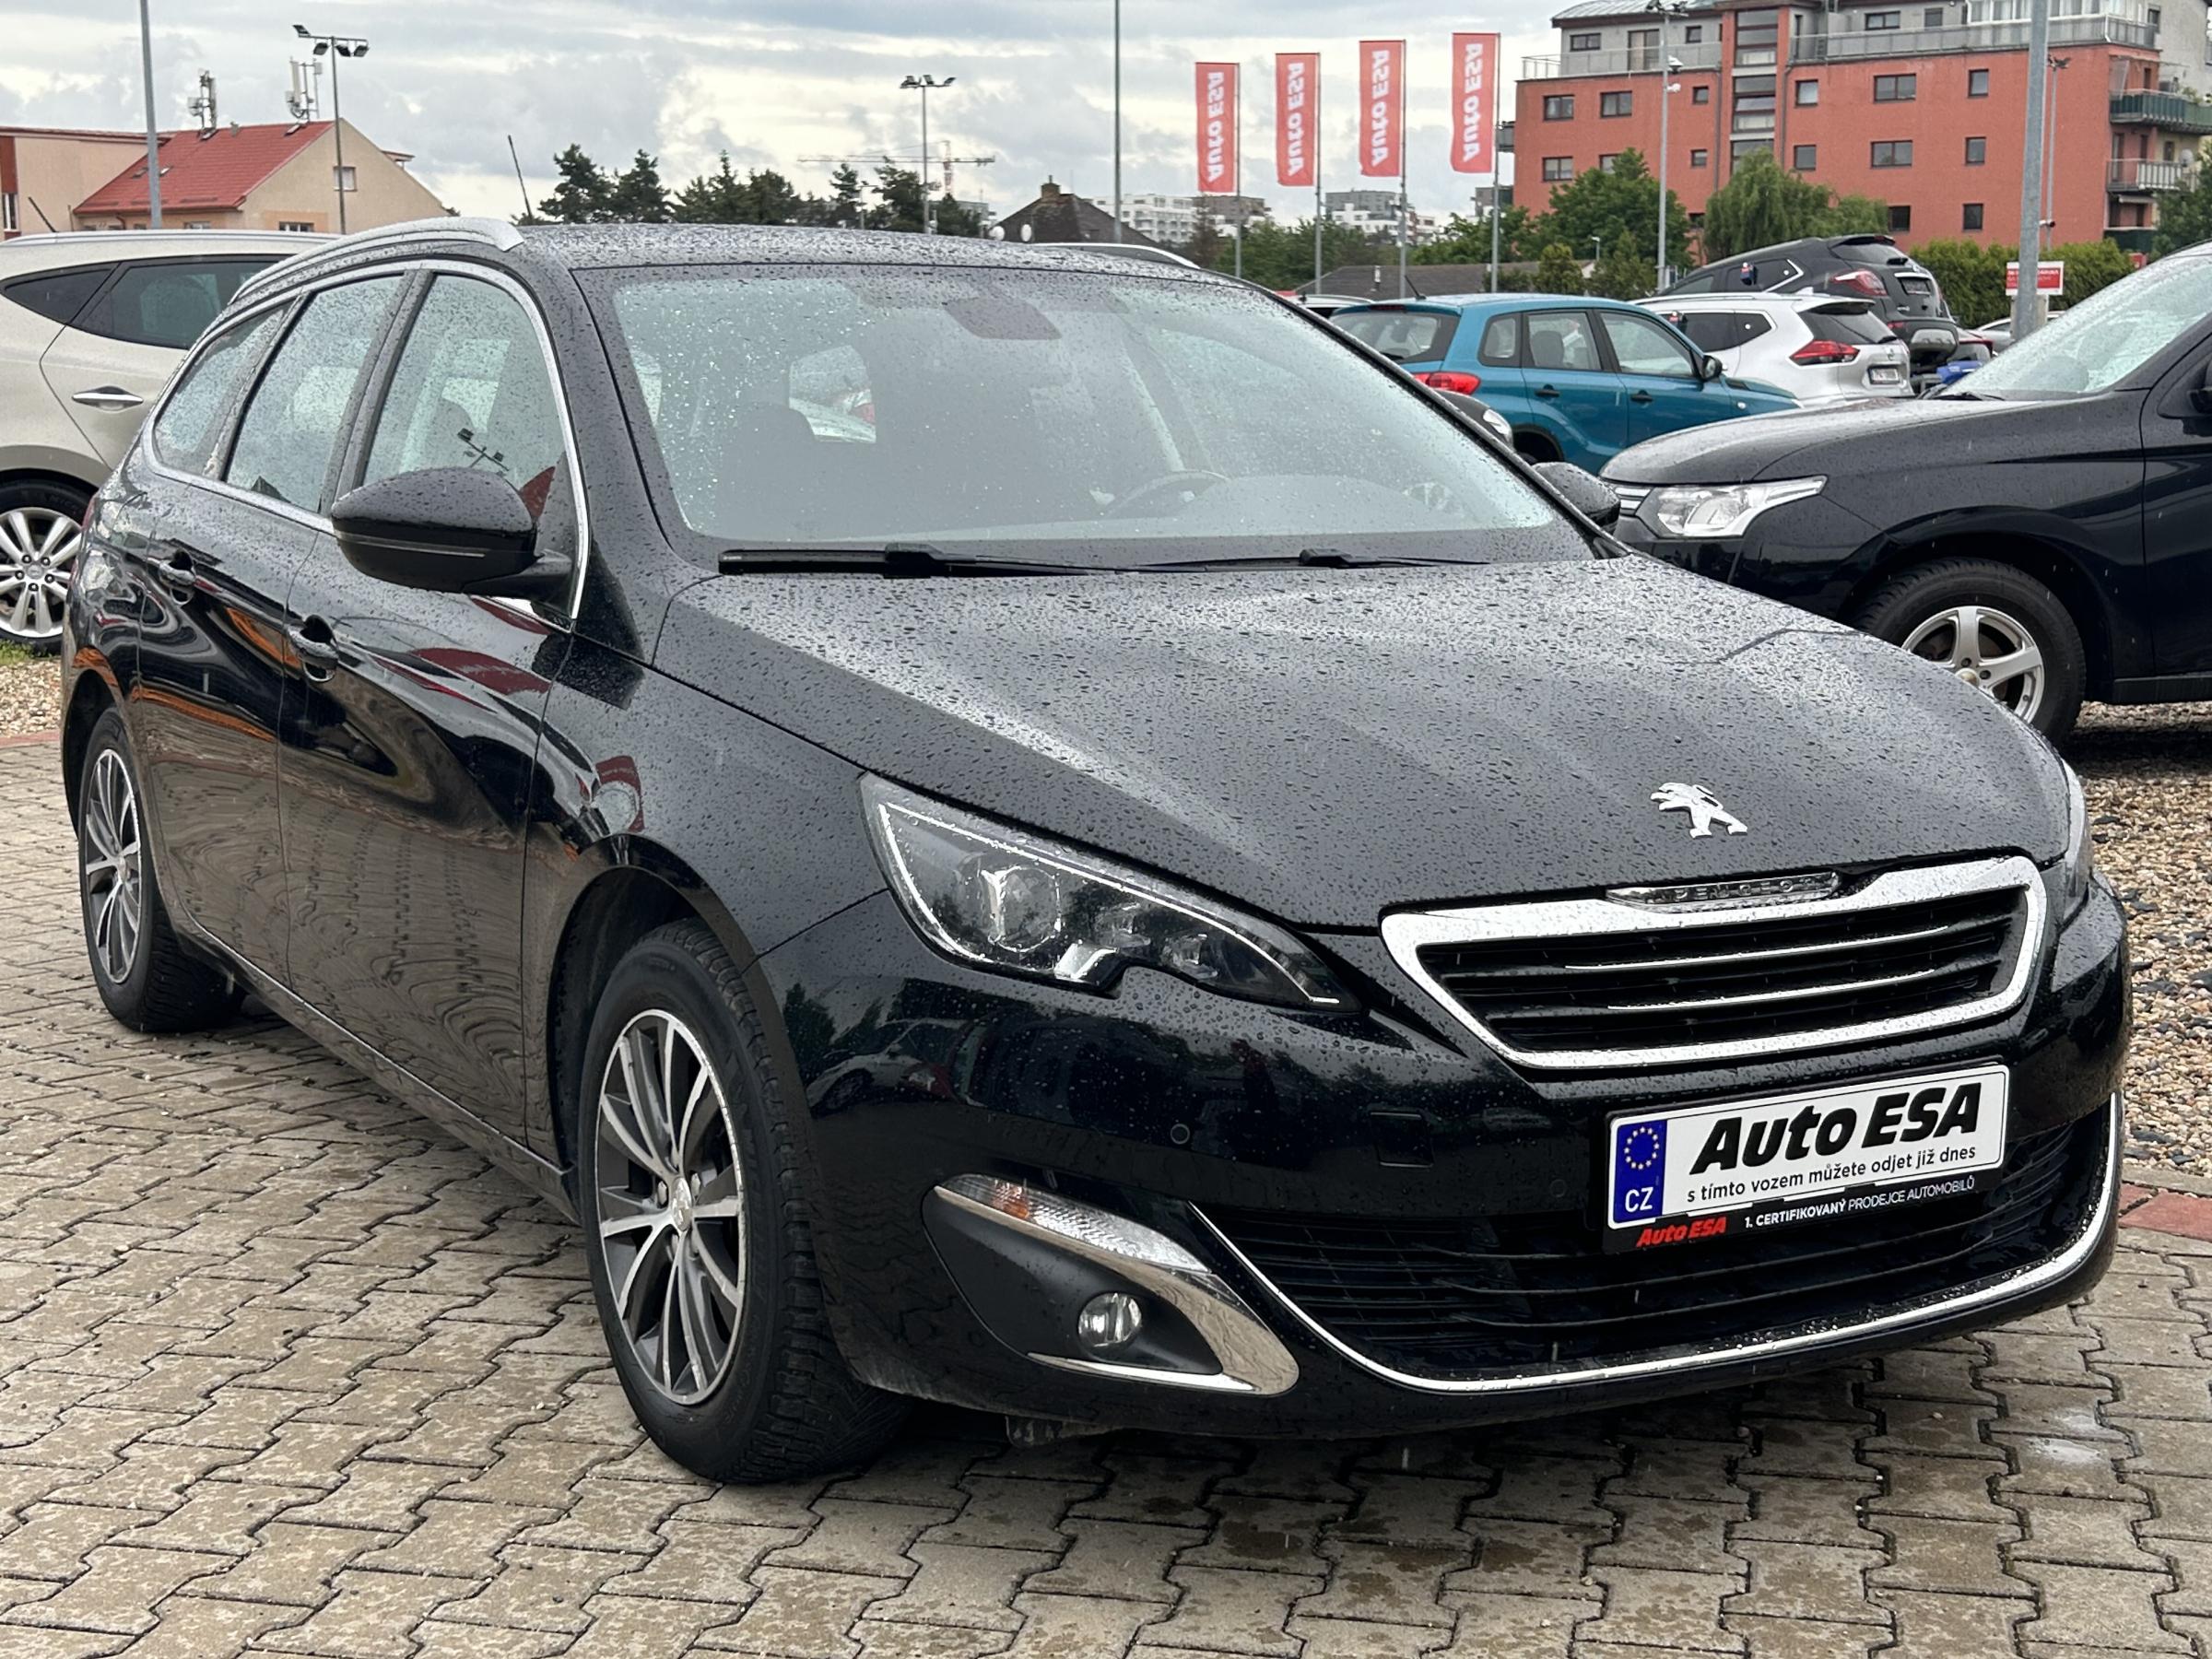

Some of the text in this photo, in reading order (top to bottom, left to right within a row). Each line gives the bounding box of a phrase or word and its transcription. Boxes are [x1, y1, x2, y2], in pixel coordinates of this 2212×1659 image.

[1688, 1082, 1982, 1175] Auto ESA
[1625, 1186, 1654, 1213] CZ
[1687, 1146, 1976, 1203] s tímto vozem můžete odjet již dnes
[1744, 1175, 1976, 1229] 1. CERTIFIKOVANÝ PRODEJCE AUTOMOBILŮ
[1636, 1216, 1727, 1248] Auto ESA
